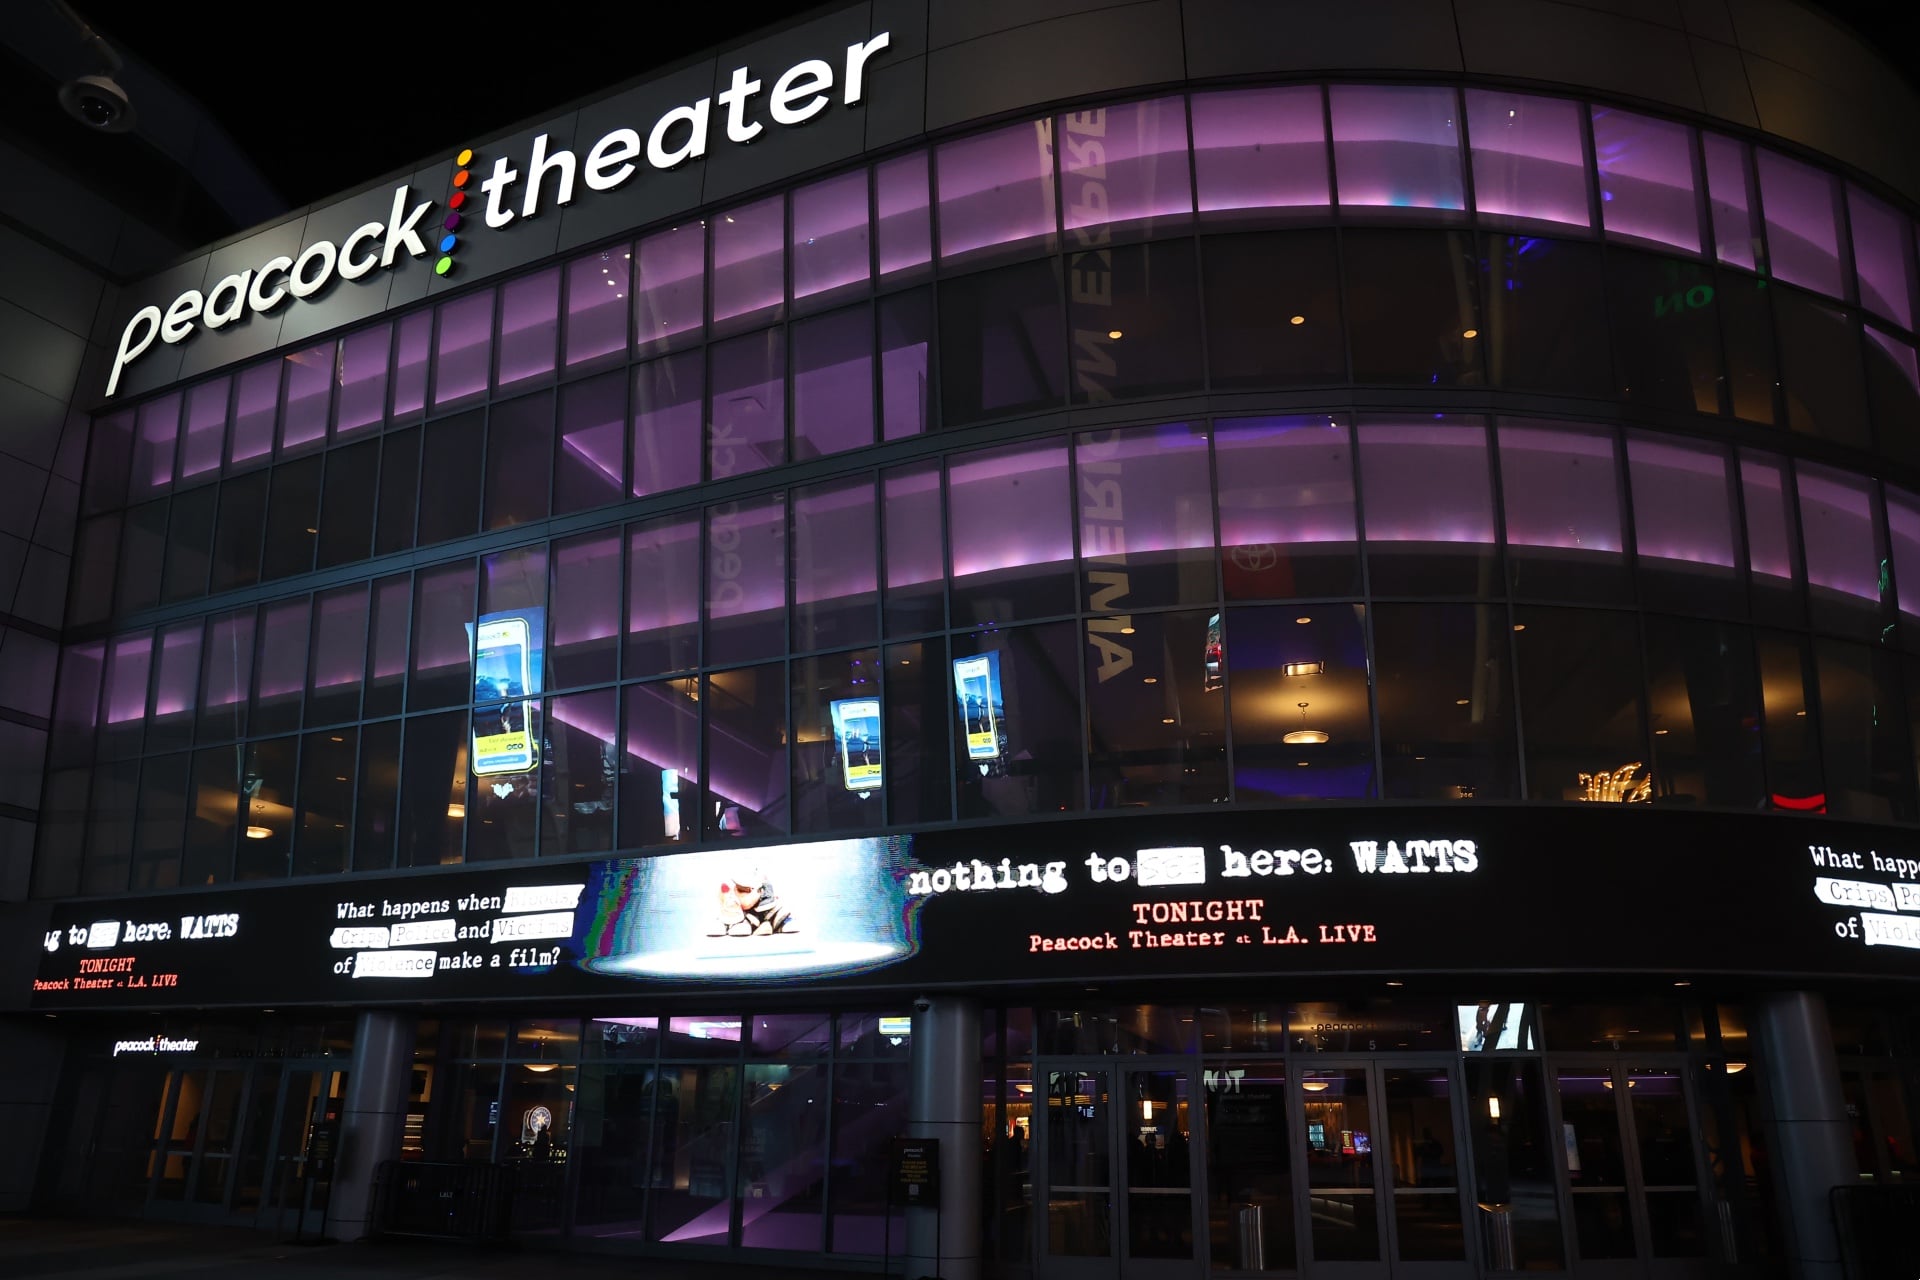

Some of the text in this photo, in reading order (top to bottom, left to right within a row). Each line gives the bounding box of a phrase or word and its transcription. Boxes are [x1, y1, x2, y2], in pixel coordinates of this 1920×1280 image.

[104, 31, 890, 397] peacock theater
[907, 857, 1068, 895] nothing
[1084, 852, 1131, 883] to
[1219, 844, 1334, 878] here:
[1349, 839, 1480, 874] WATTS
[1808, 845, 1920, 880] What happ
[337, 901, 375, 919] What
[381, 898, 451, 921] happens
[457, 893, 501, 912] when
[1132, 899, 1264, 925] TONIGHT
[68, 924, 87, 946] to
[180, 913, 240, 940] WATTS
[457, 919, 491, 940] and
[1029, 924, 1377, 953] Peacock Theater at L.A. LIVE
[1835, 916, 1859, 939] of
[79, 956, 136, 974] TONIGHT
[333, 955, 352, 975] of
[438, 950, 483, 970] make
[489, 954, 501, 969] a
[508, 945, 561, 967] film?
[33, 977, 70, 992] Peacock
[73, 976, 115, 990] Theater
[151, 973, 178, 988] LIVE
[113, 1036, 199, 1057] peacock theater
[1368, 1040, 1377, 1050] 5
